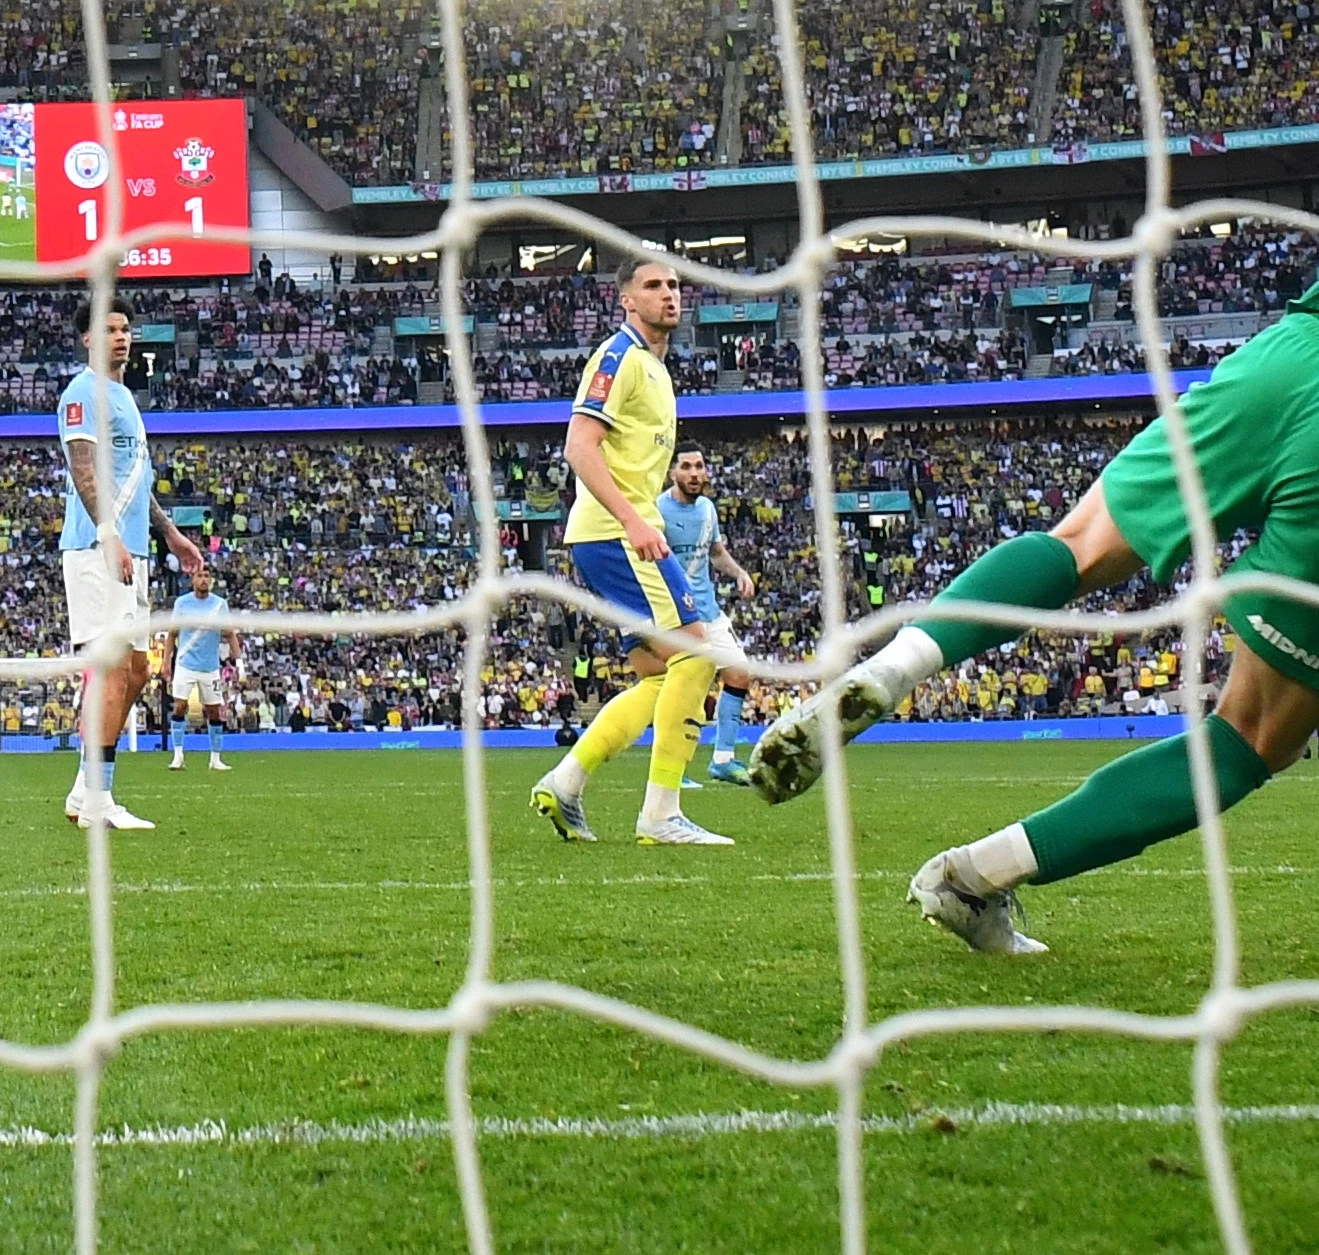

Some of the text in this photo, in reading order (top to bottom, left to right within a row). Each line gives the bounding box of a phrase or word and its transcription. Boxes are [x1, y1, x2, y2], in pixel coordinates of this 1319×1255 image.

[865, 160, 920, 174] WEMBLEY
[127, 178, 157, 197] VS
[355, 189, 408, 201] WEMBLEY
[523, 181, 576, 193] WEMBLEY
[78, 199, 97, 240] 1
[185, 196, 204, 238] 1
